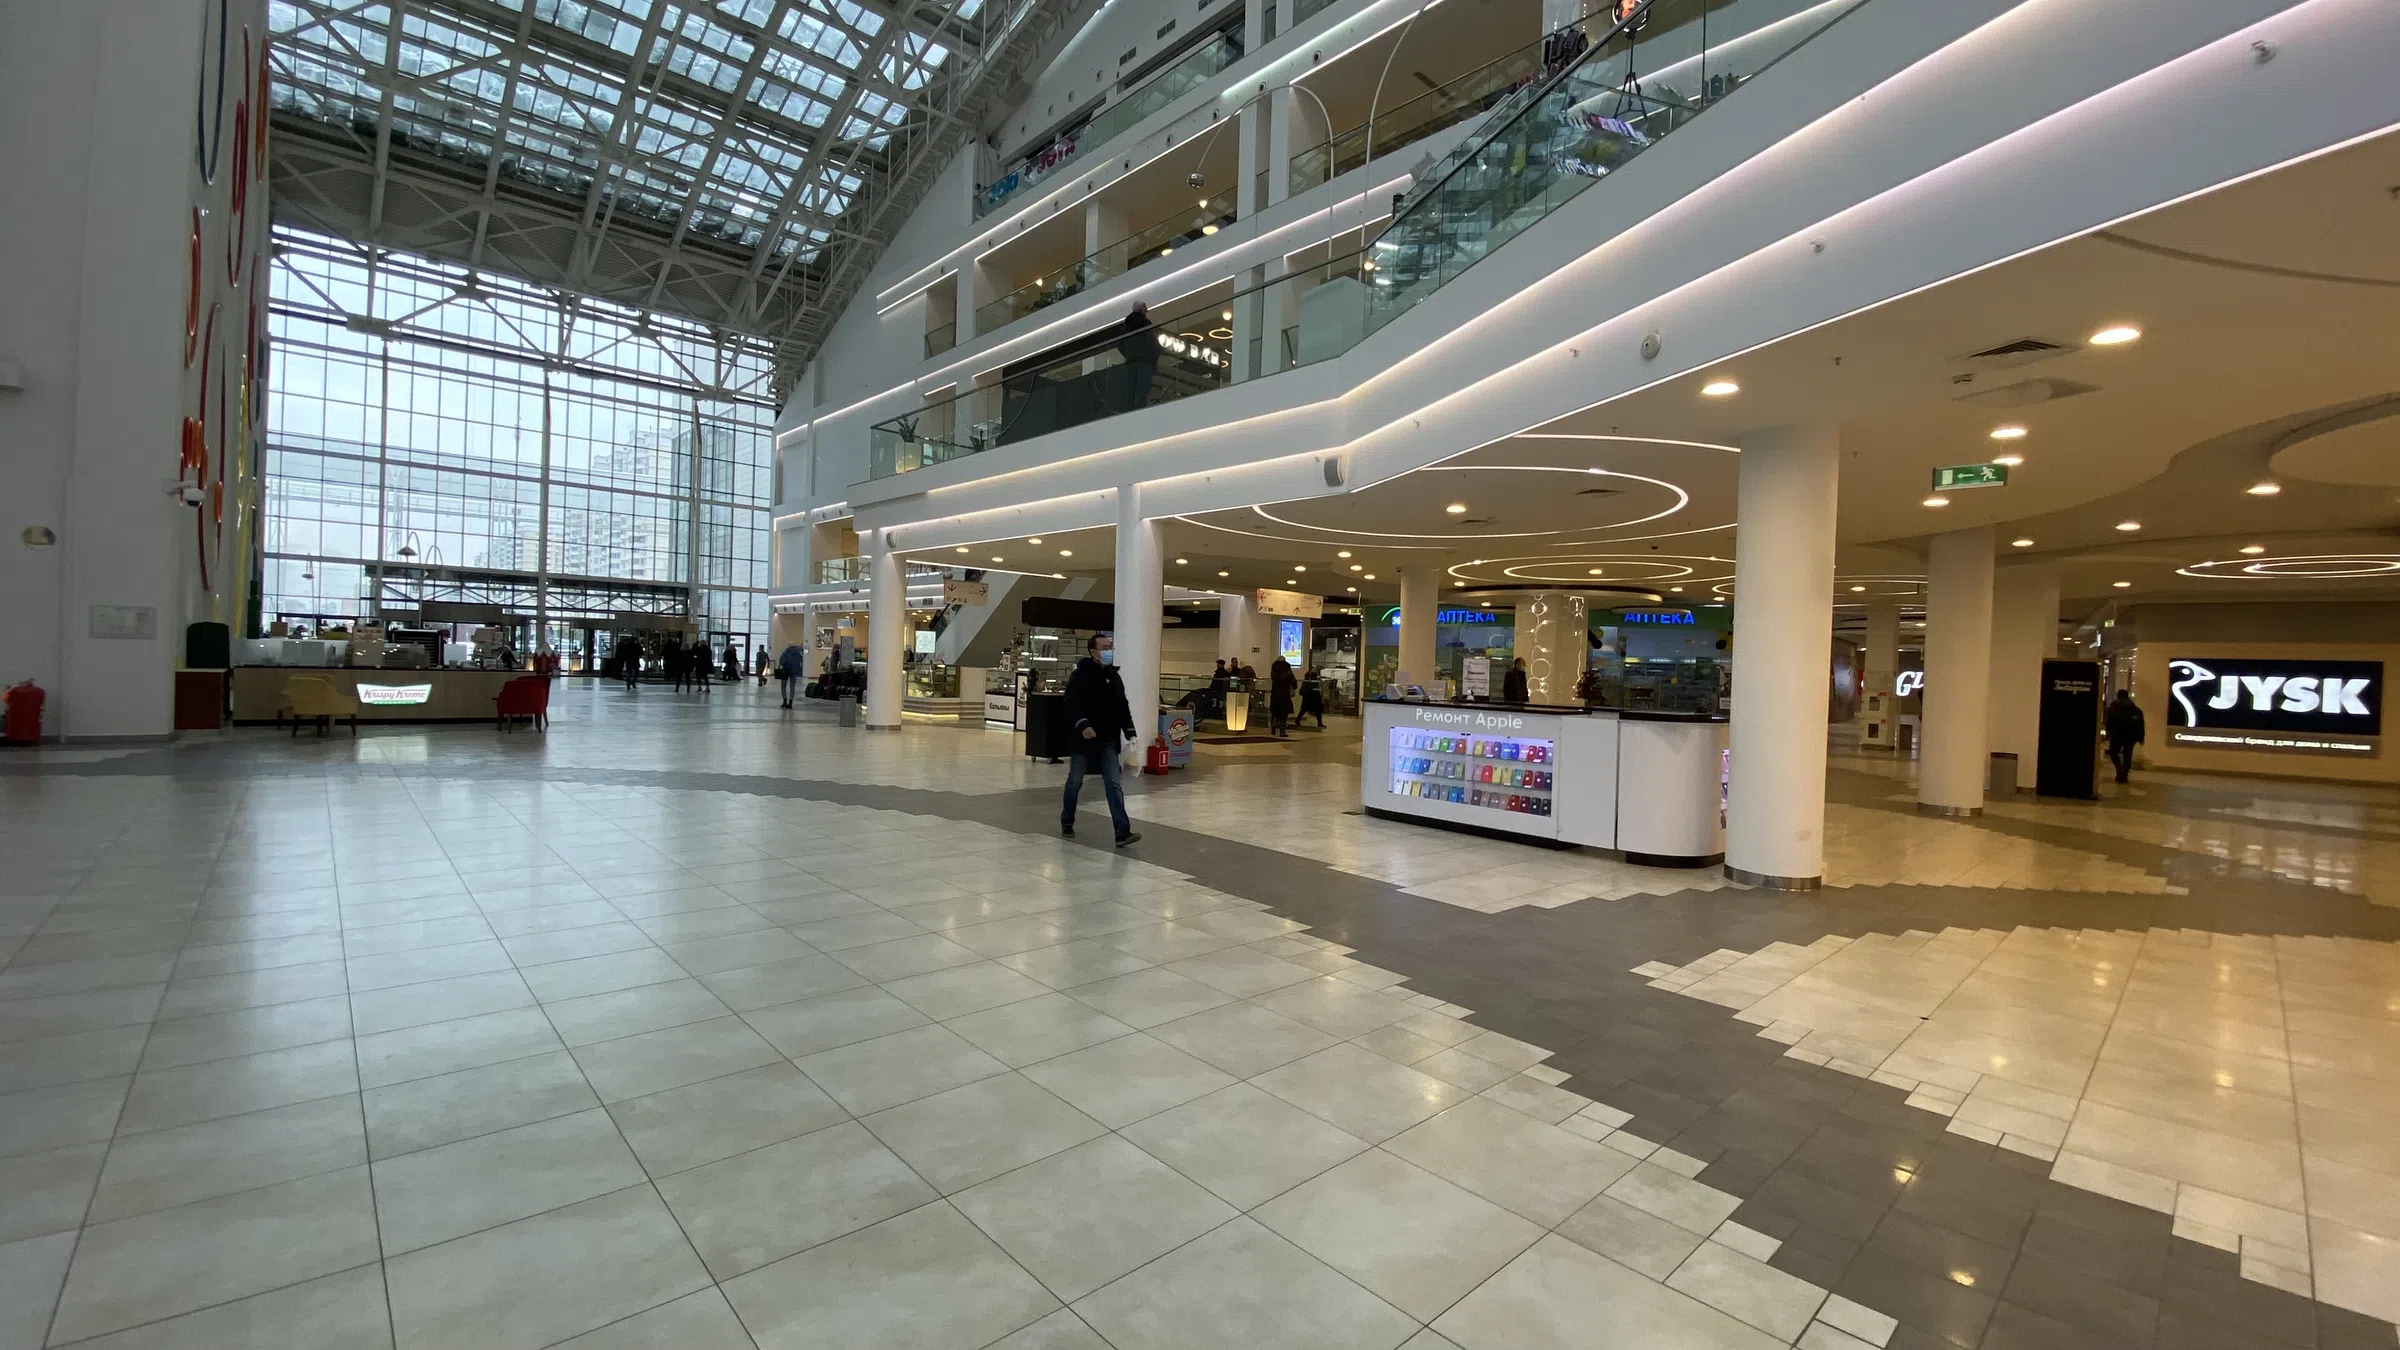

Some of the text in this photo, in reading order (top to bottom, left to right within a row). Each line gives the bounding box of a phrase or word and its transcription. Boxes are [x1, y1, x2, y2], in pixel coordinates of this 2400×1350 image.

[1437, 609, 1496, 624] АПТЕКА
[1895, 670, 1924, 697] GL
[2207, 675, 2371, 715] JYSK
[1415, 708, 1523, 730] Ремонт Apple
